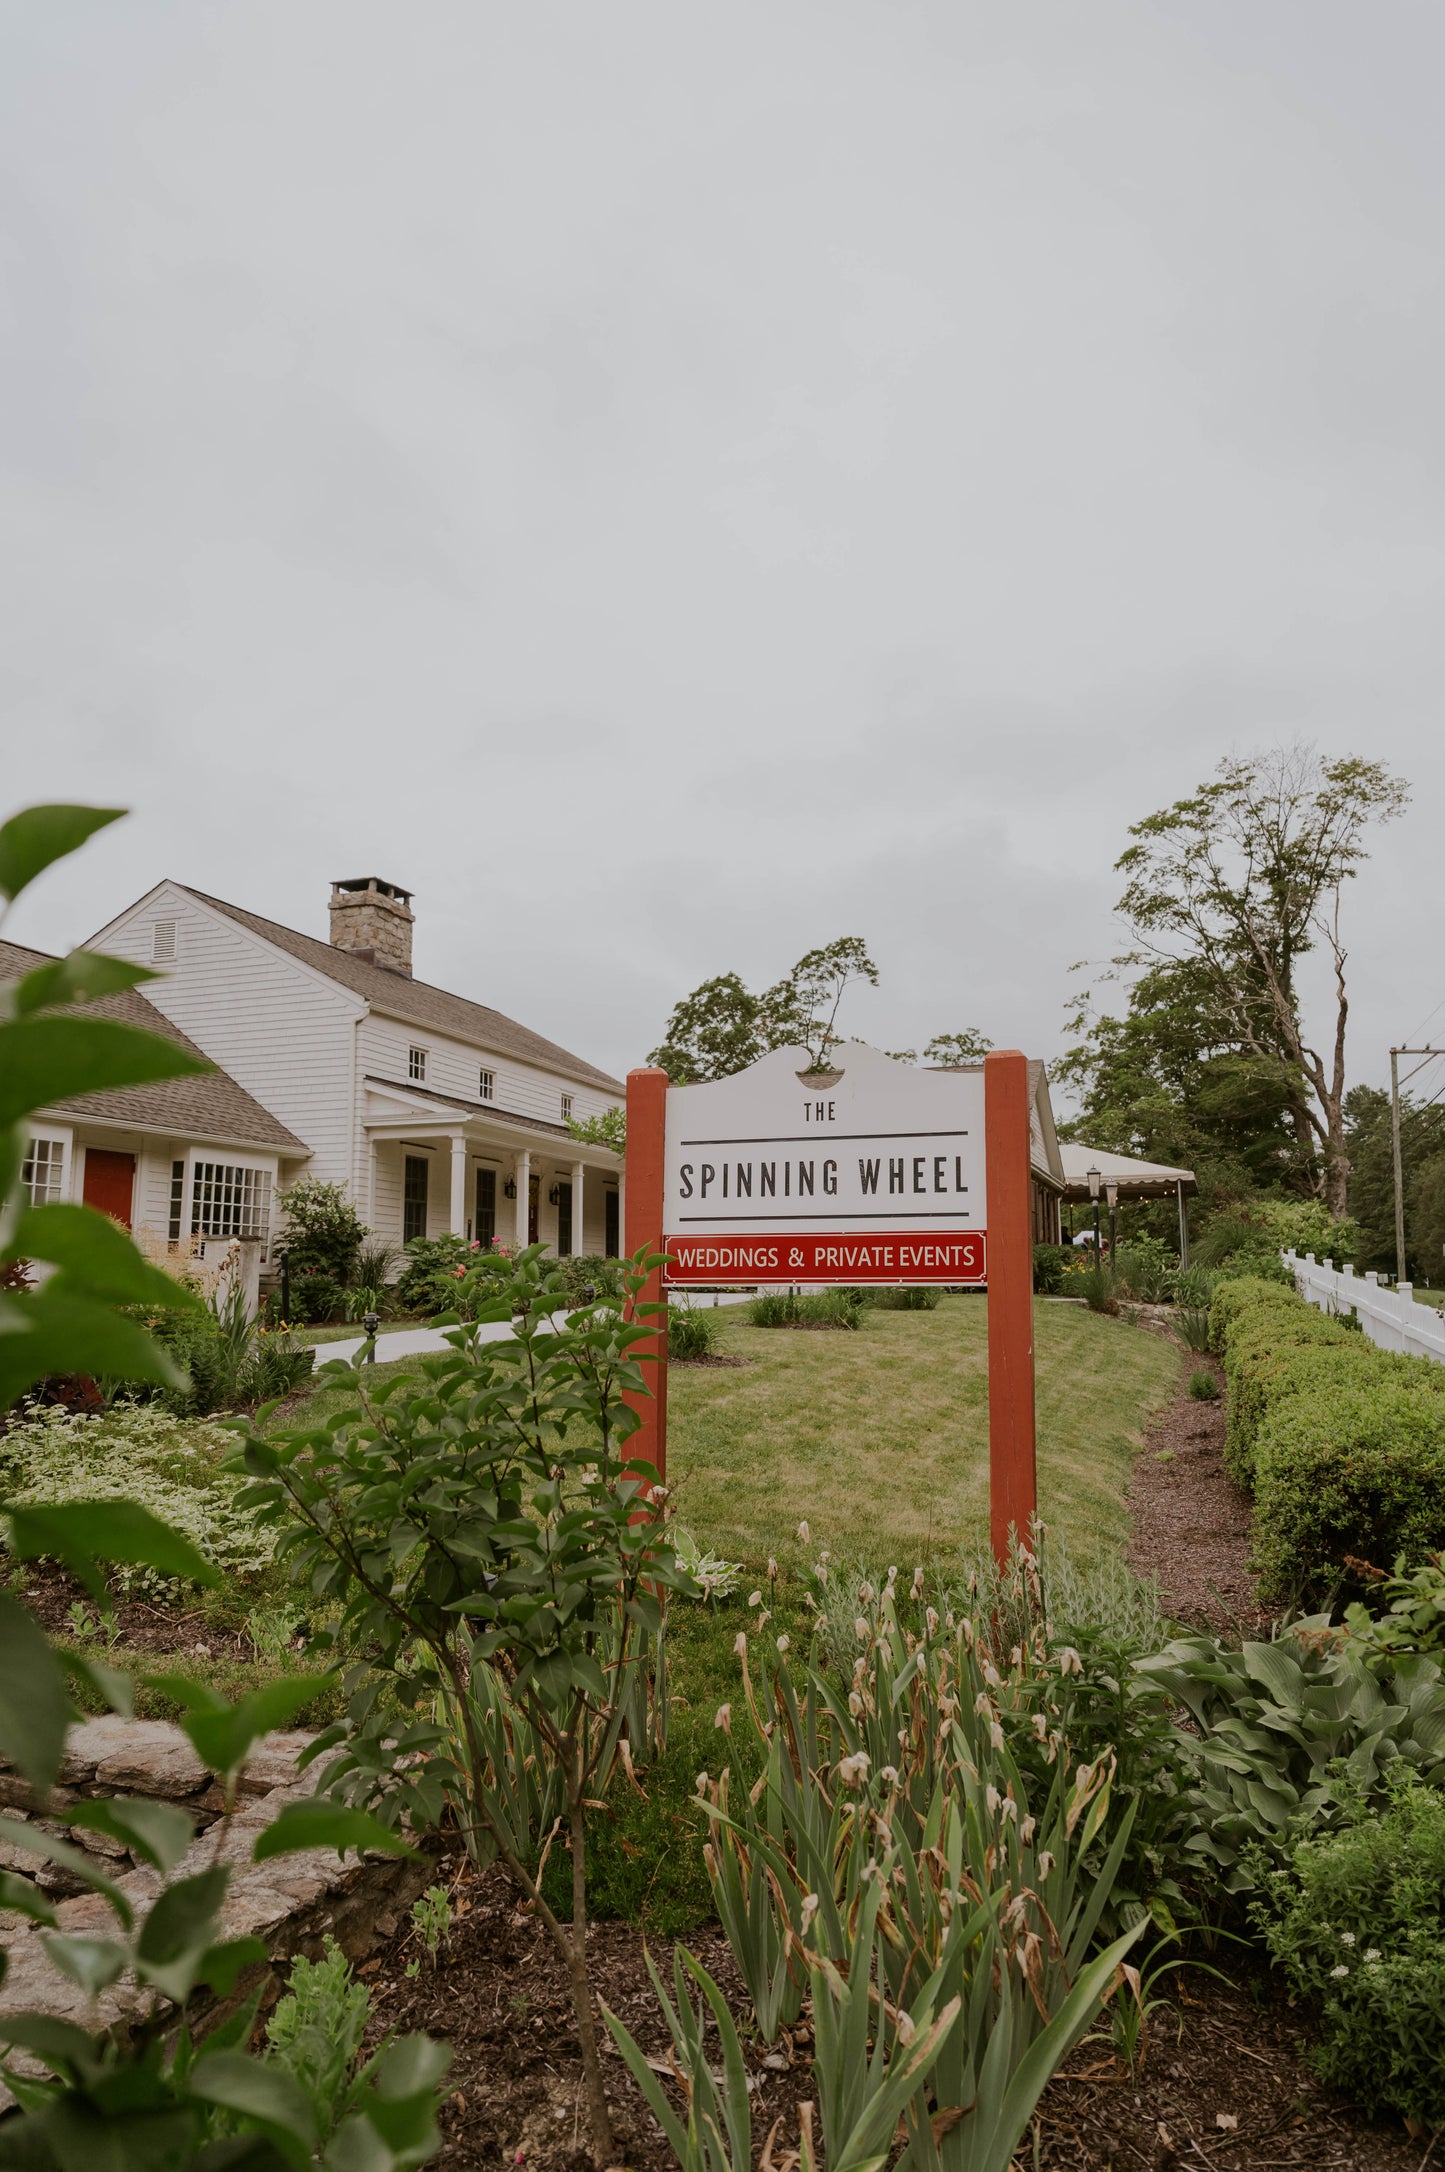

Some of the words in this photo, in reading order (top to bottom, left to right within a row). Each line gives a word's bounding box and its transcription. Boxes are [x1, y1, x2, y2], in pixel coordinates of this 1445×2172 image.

[804, 1102, 835, 1121] THE
[679, 1159, 838, 1199] SPINNING
[858, 1156, 969, 1194] WHEEL
[677, 1247, 779, 1268] WEDDINGS
[788, 1247, 805, 1267] &
[814, 1246, 894, 1267] PRIVATE
[899, 1245, 975, 1266] EVENTS
